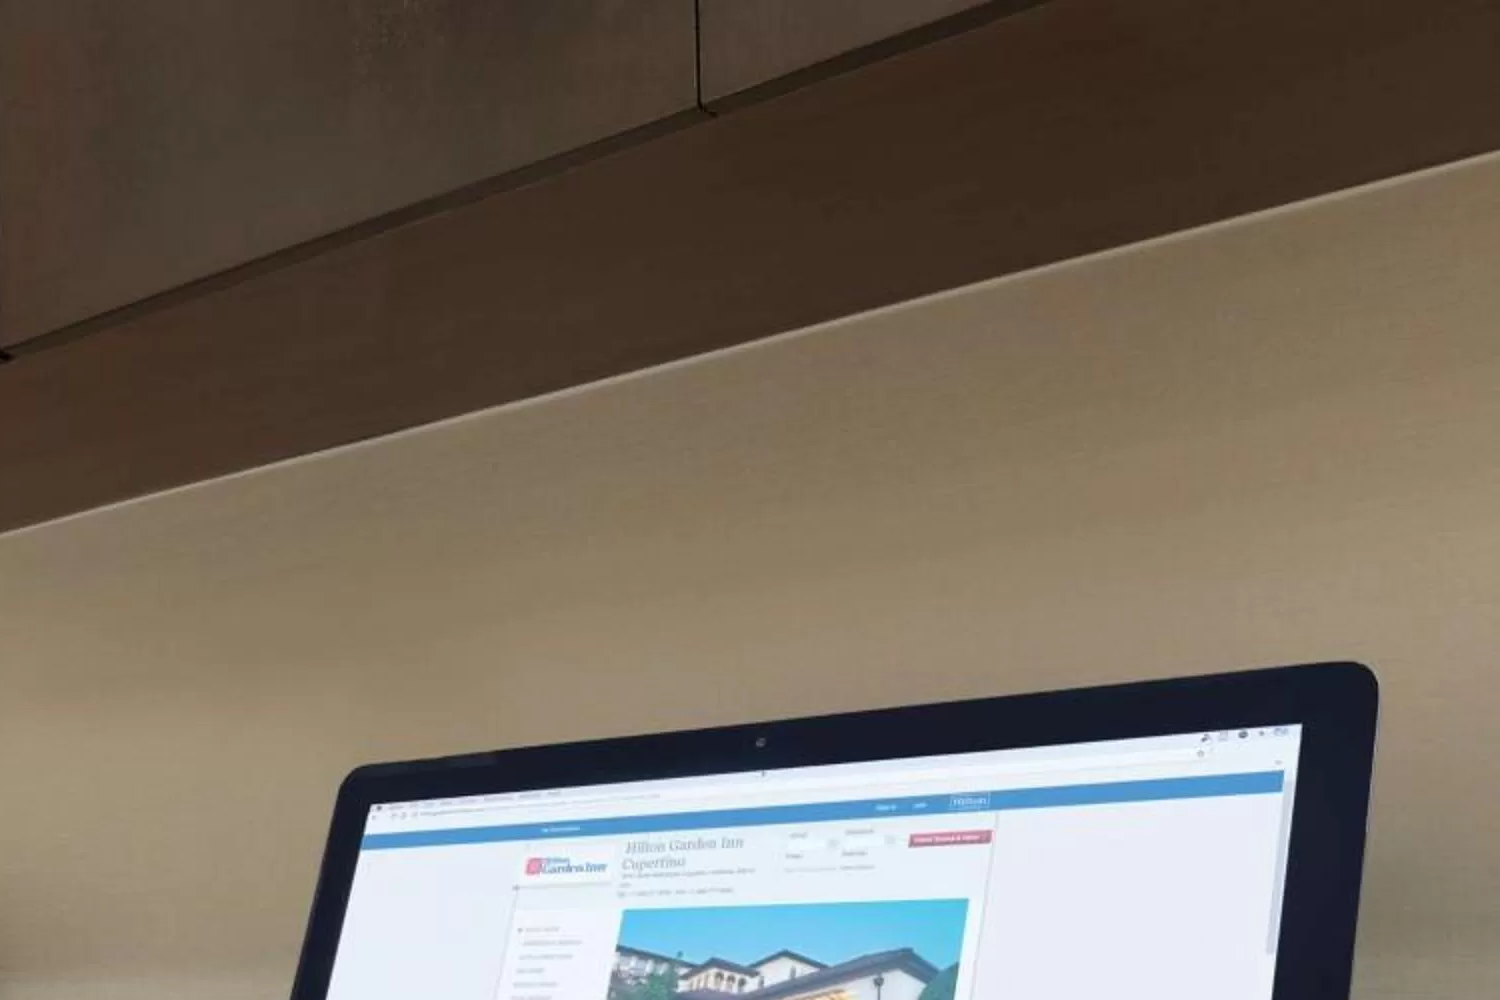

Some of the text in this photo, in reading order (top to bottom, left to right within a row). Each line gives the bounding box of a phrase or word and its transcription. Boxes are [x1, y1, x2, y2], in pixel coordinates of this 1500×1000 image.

[625, 836, 745, 855] Hilton Garden Inn
[621, 856, 687, 873] Cupertino
